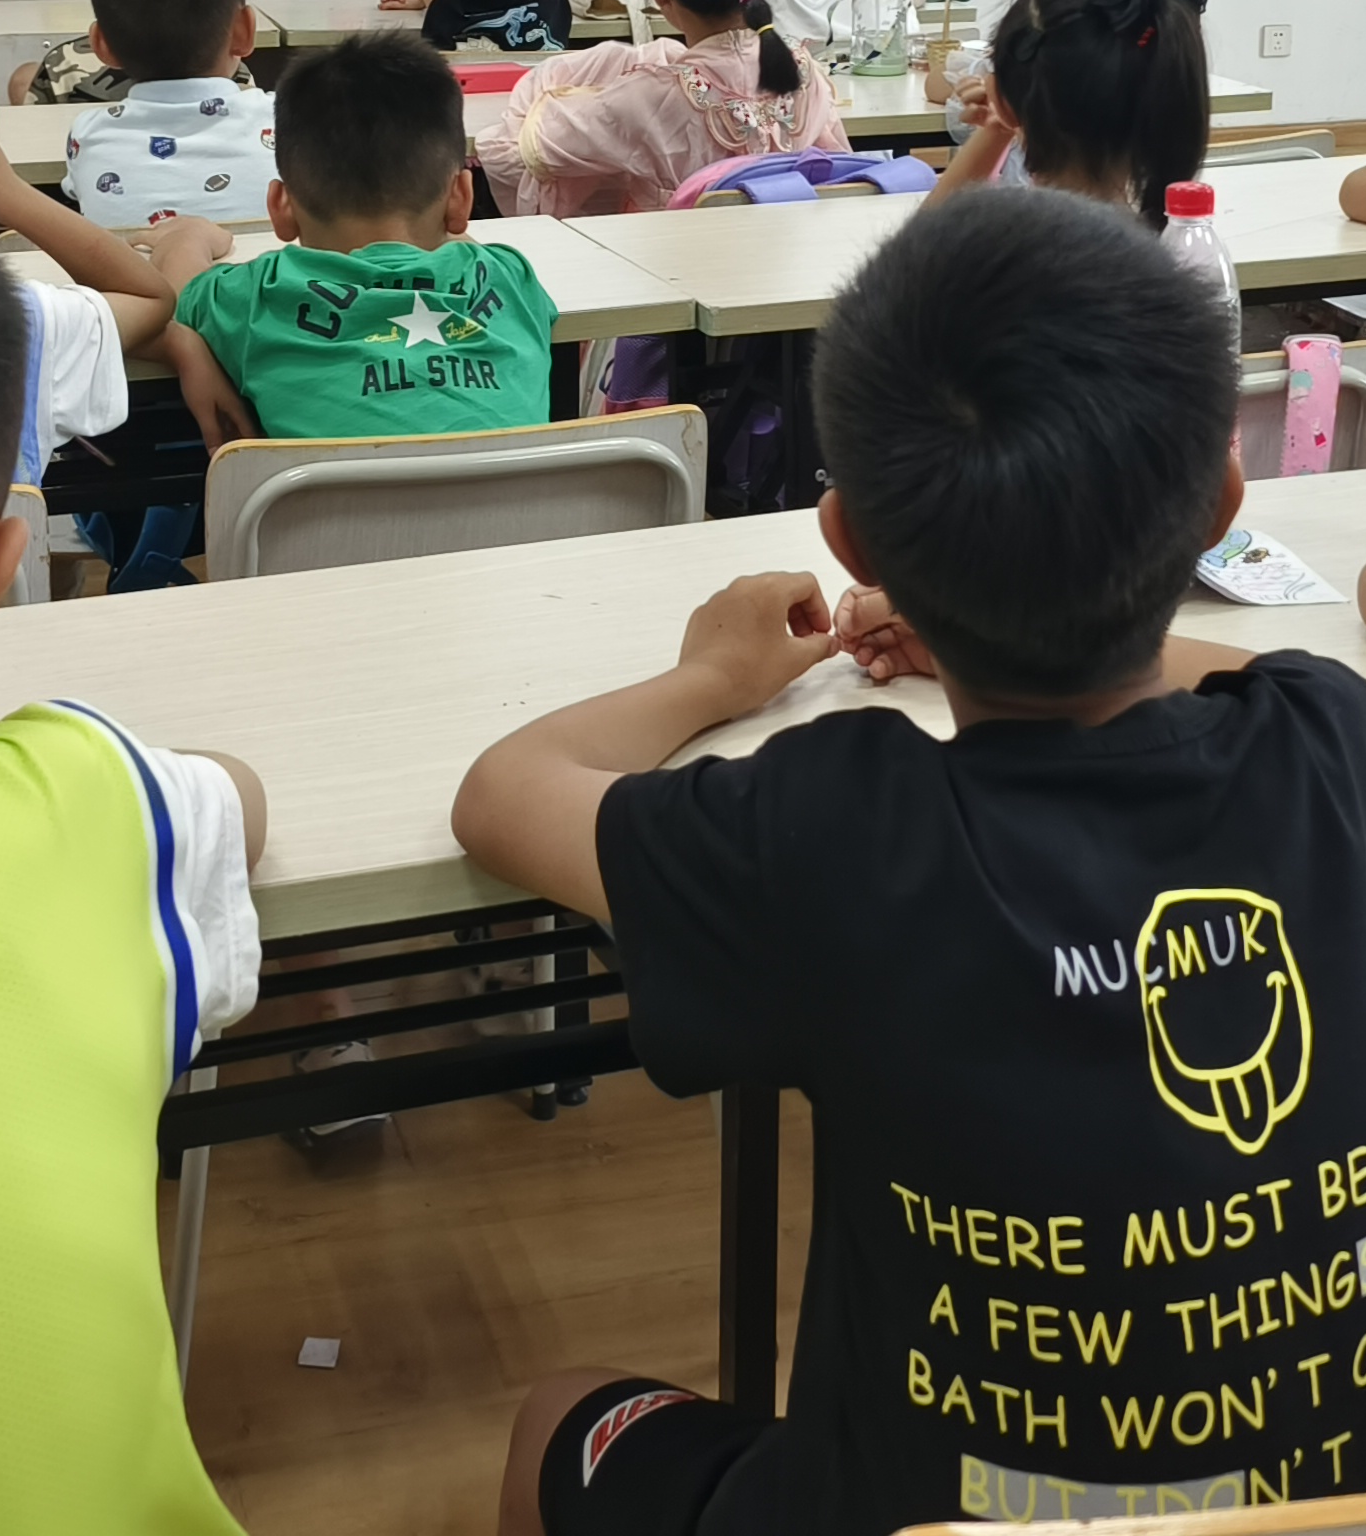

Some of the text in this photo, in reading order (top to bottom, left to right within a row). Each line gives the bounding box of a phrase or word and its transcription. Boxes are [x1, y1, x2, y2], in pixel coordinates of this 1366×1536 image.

[361, 355, 501, 396] ALL STAR
[890, 1181, 1086, 1275] THERE
[1123, 1178, 1292, 1269] MUST
[929, 1284, 959, 1336] A
[988, 1297, 1132, 1364] FEW
[908, 1348, 1068, 1448] BATH
[960, 1453, 1087, 1524] BUT
